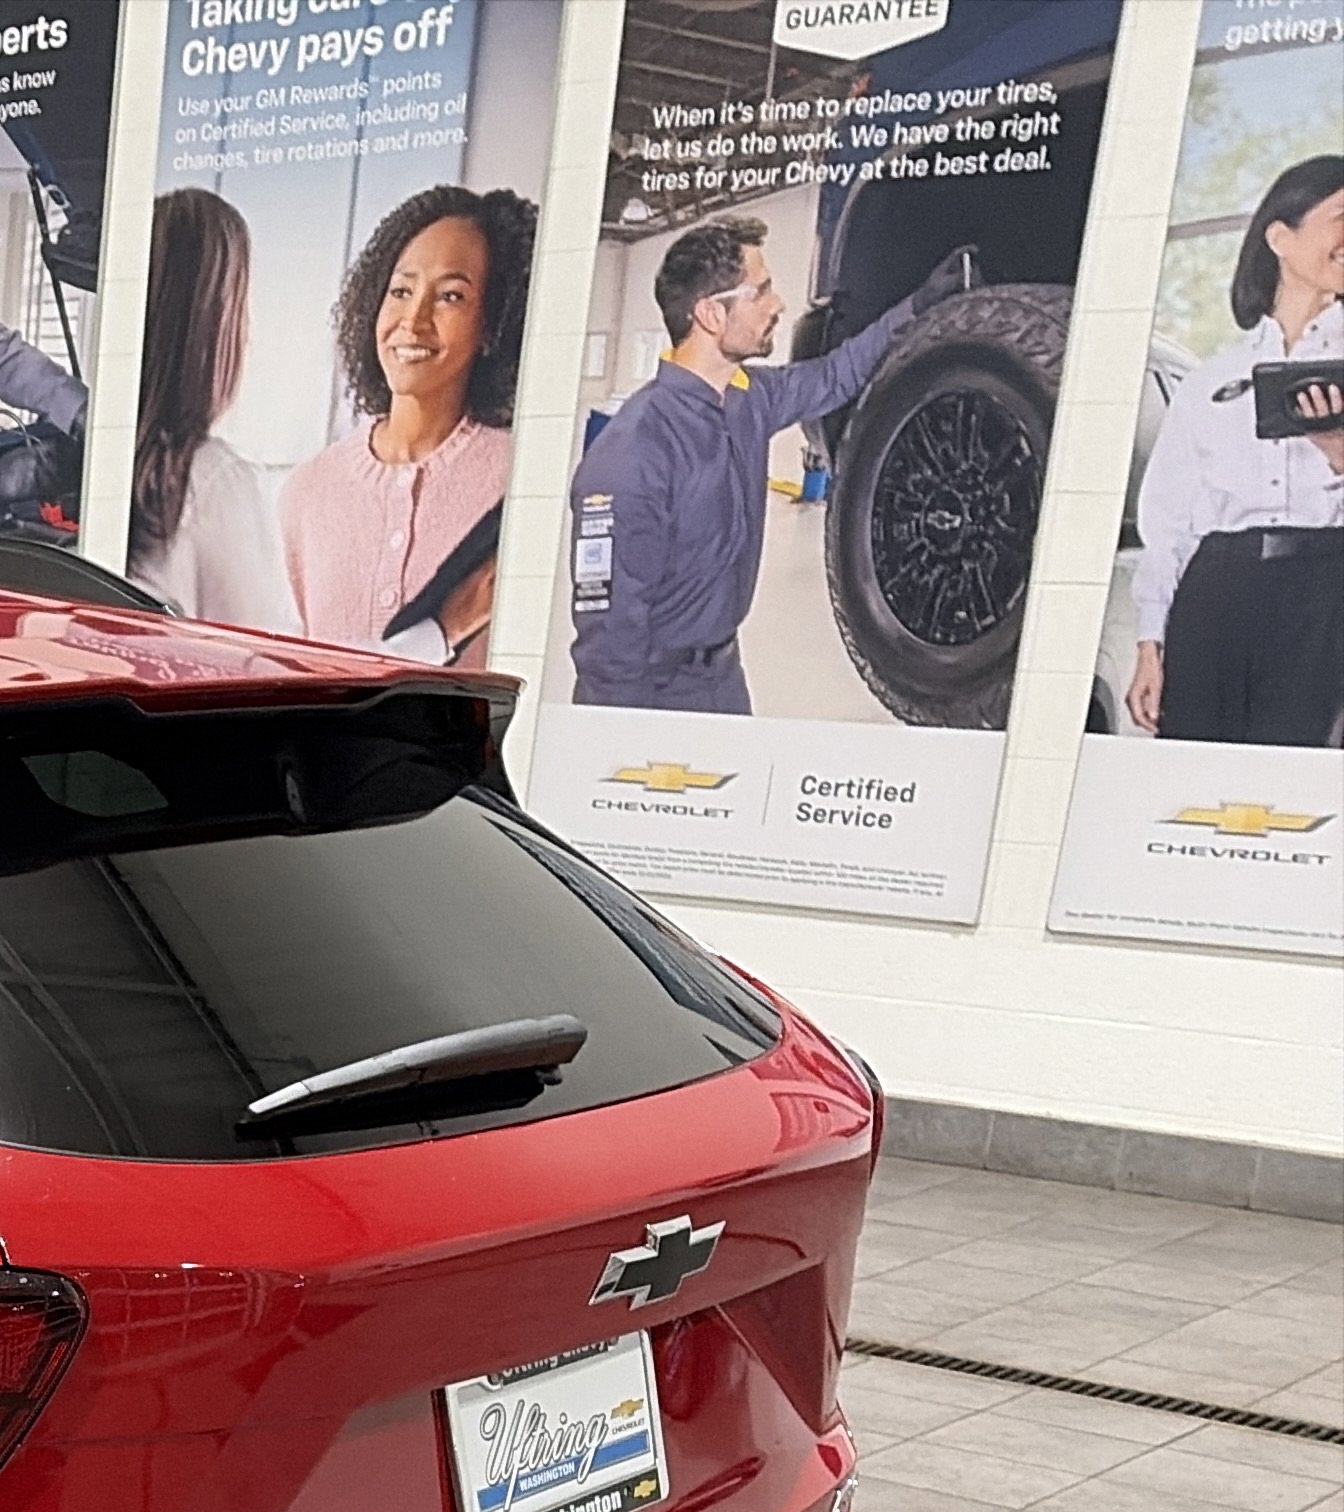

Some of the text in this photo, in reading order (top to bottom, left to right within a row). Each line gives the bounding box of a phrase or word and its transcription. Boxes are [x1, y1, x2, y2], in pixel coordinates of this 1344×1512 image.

[187, 0, 297, 29] Taking
[786, 0, 938, 30] GUARANTEE
[182, 4, 454, 77] Chevy pays off
[1224, 14, 1327, 51] getting
[13, 69, 56, 91] know
[178, 96, 210, 117] Use
[213, 93, 252, 117] your
[255, 88, 285, 109] GM
[383, 72, 442, 97] points
[175, 92, 467, 143] on Certified Service, including oil
[652, 79, 1057, 129] When it's time to replace your tires,
[173, 127, 468, 172] changes, tire rotations and more.
[643, 110, 1062, 161] let us do the work. We have the right
[641, 144, 1052, 192] tires for your Chevy at the best deal.
[800, 775, 916, 803] Certified
[591, 798, 735, 820] CHEVROLET
[796, 802, 893, 830] Service
[1147, 842, 1331, 866] CHEVROLET
[519, 1461, 576, 1492] WASHINGTON
